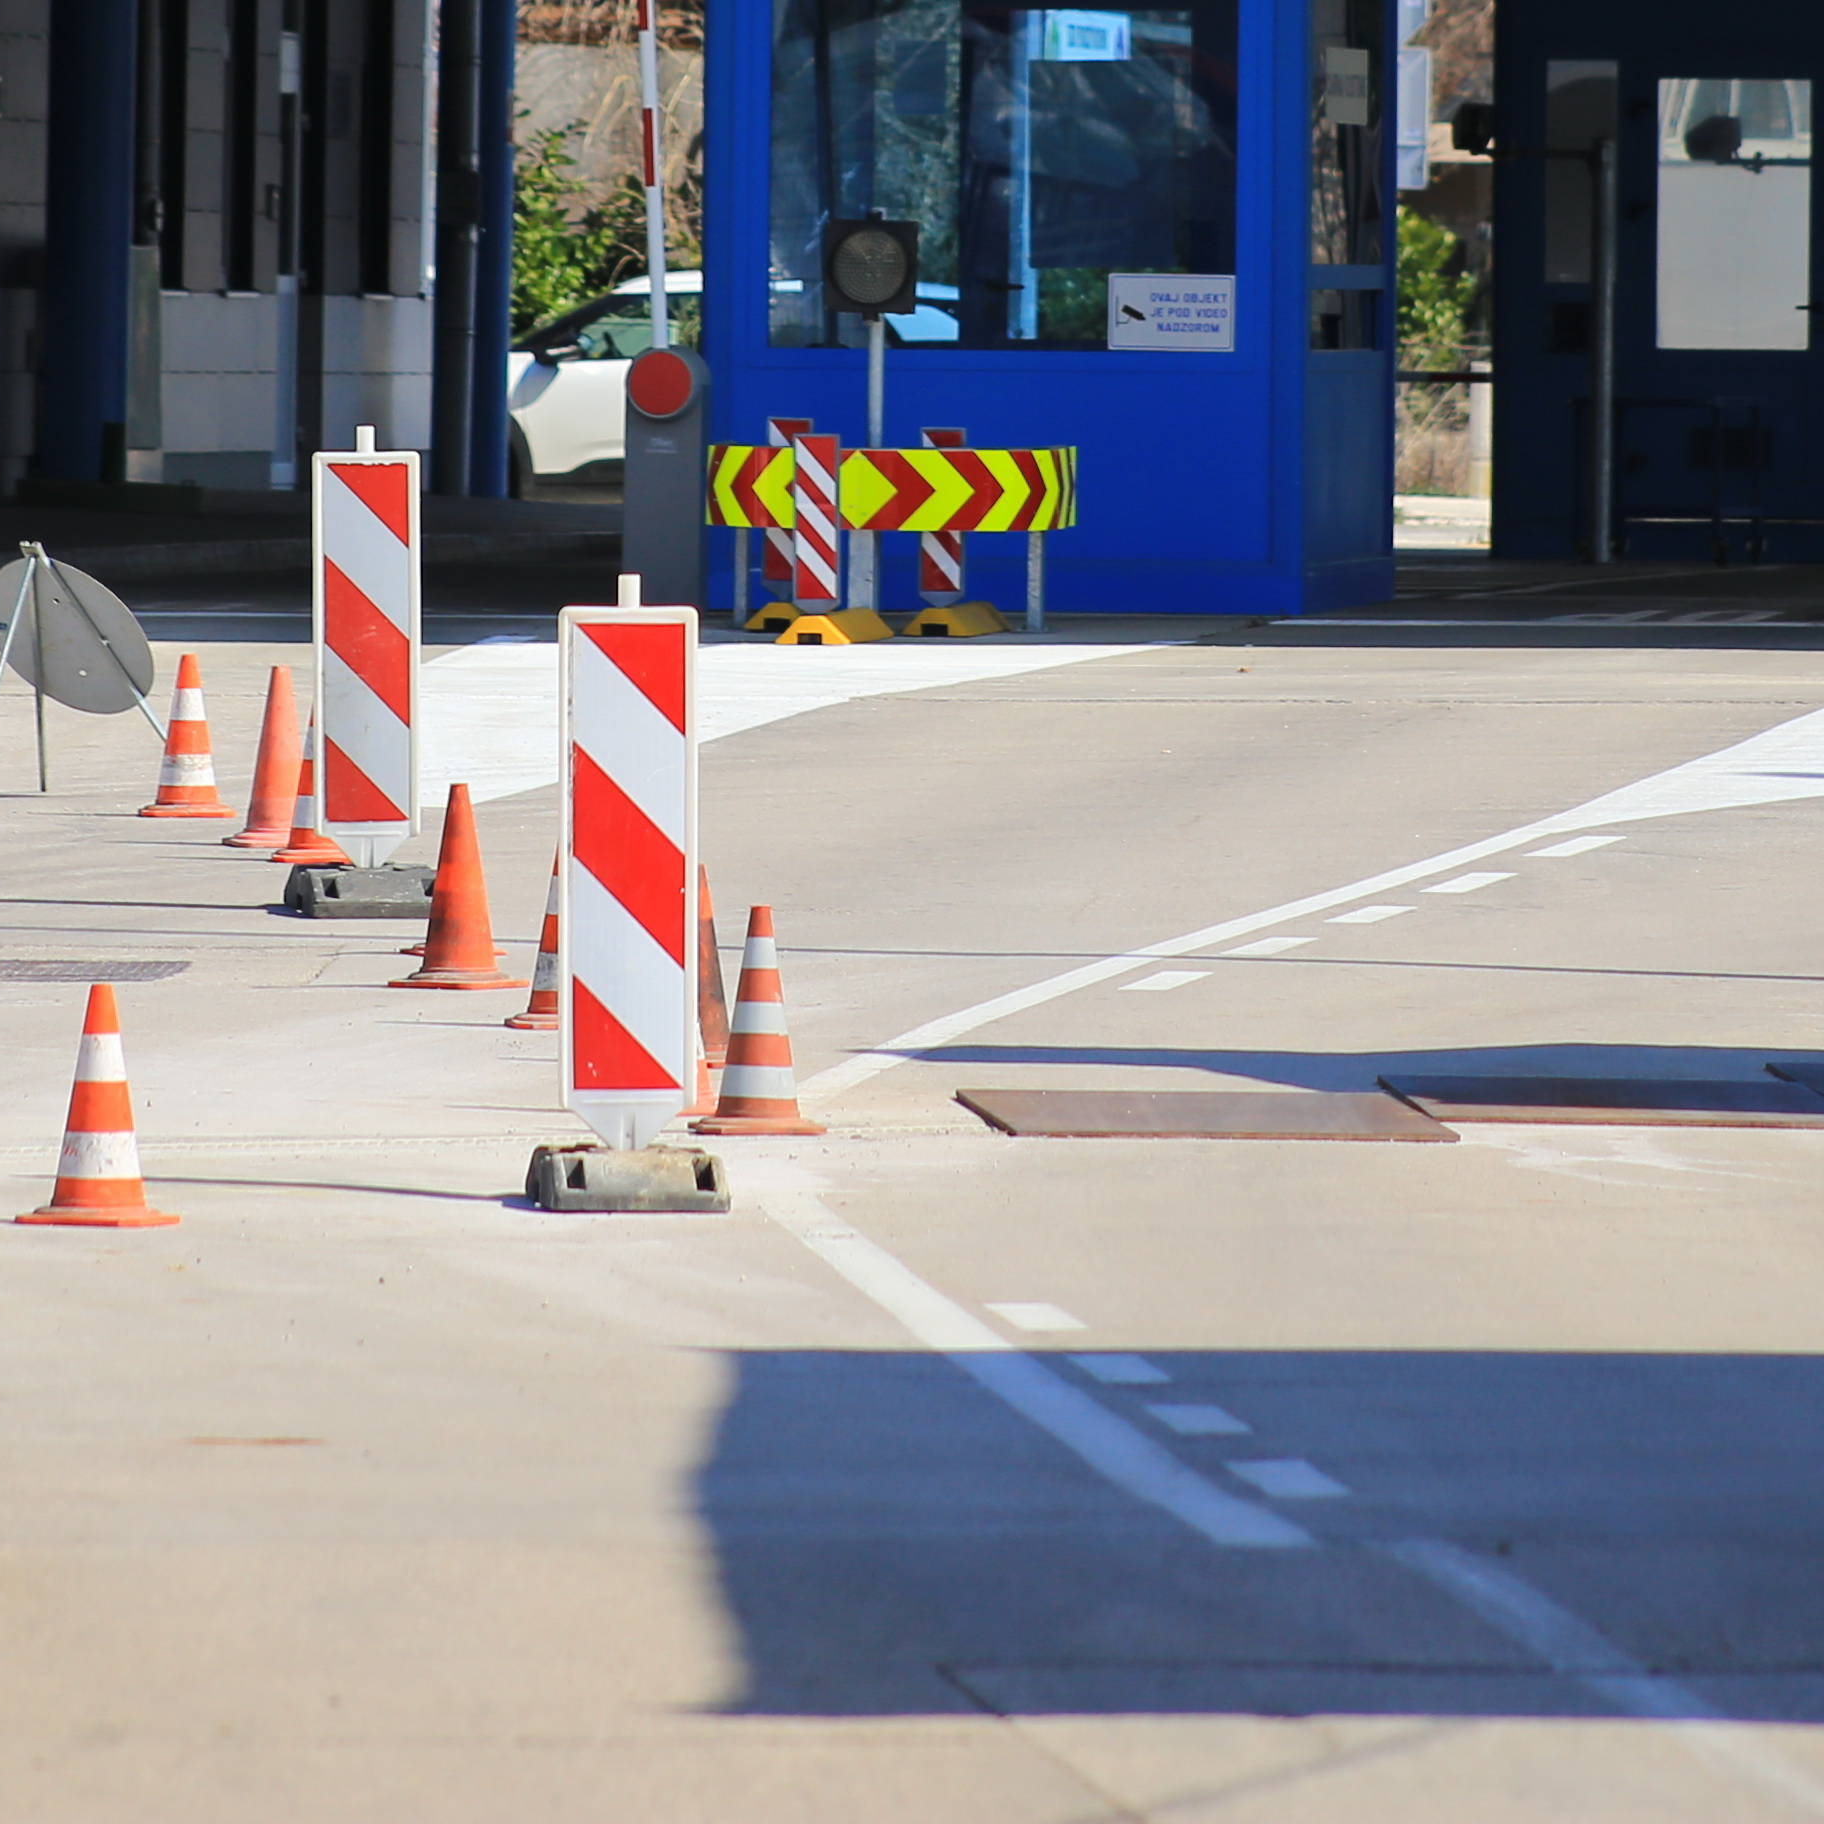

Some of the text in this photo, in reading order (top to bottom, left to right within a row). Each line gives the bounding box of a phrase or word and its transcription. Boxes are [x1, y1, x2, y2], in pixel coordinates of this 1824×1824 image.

[1149, 292, 1228, 304] OVAJ OBJEKT
[1149, 307, 1164, 318] JE
[1195, 308, 1228, 318] VIDEO
[1156, 322, 1220, 333] NADZOROM
